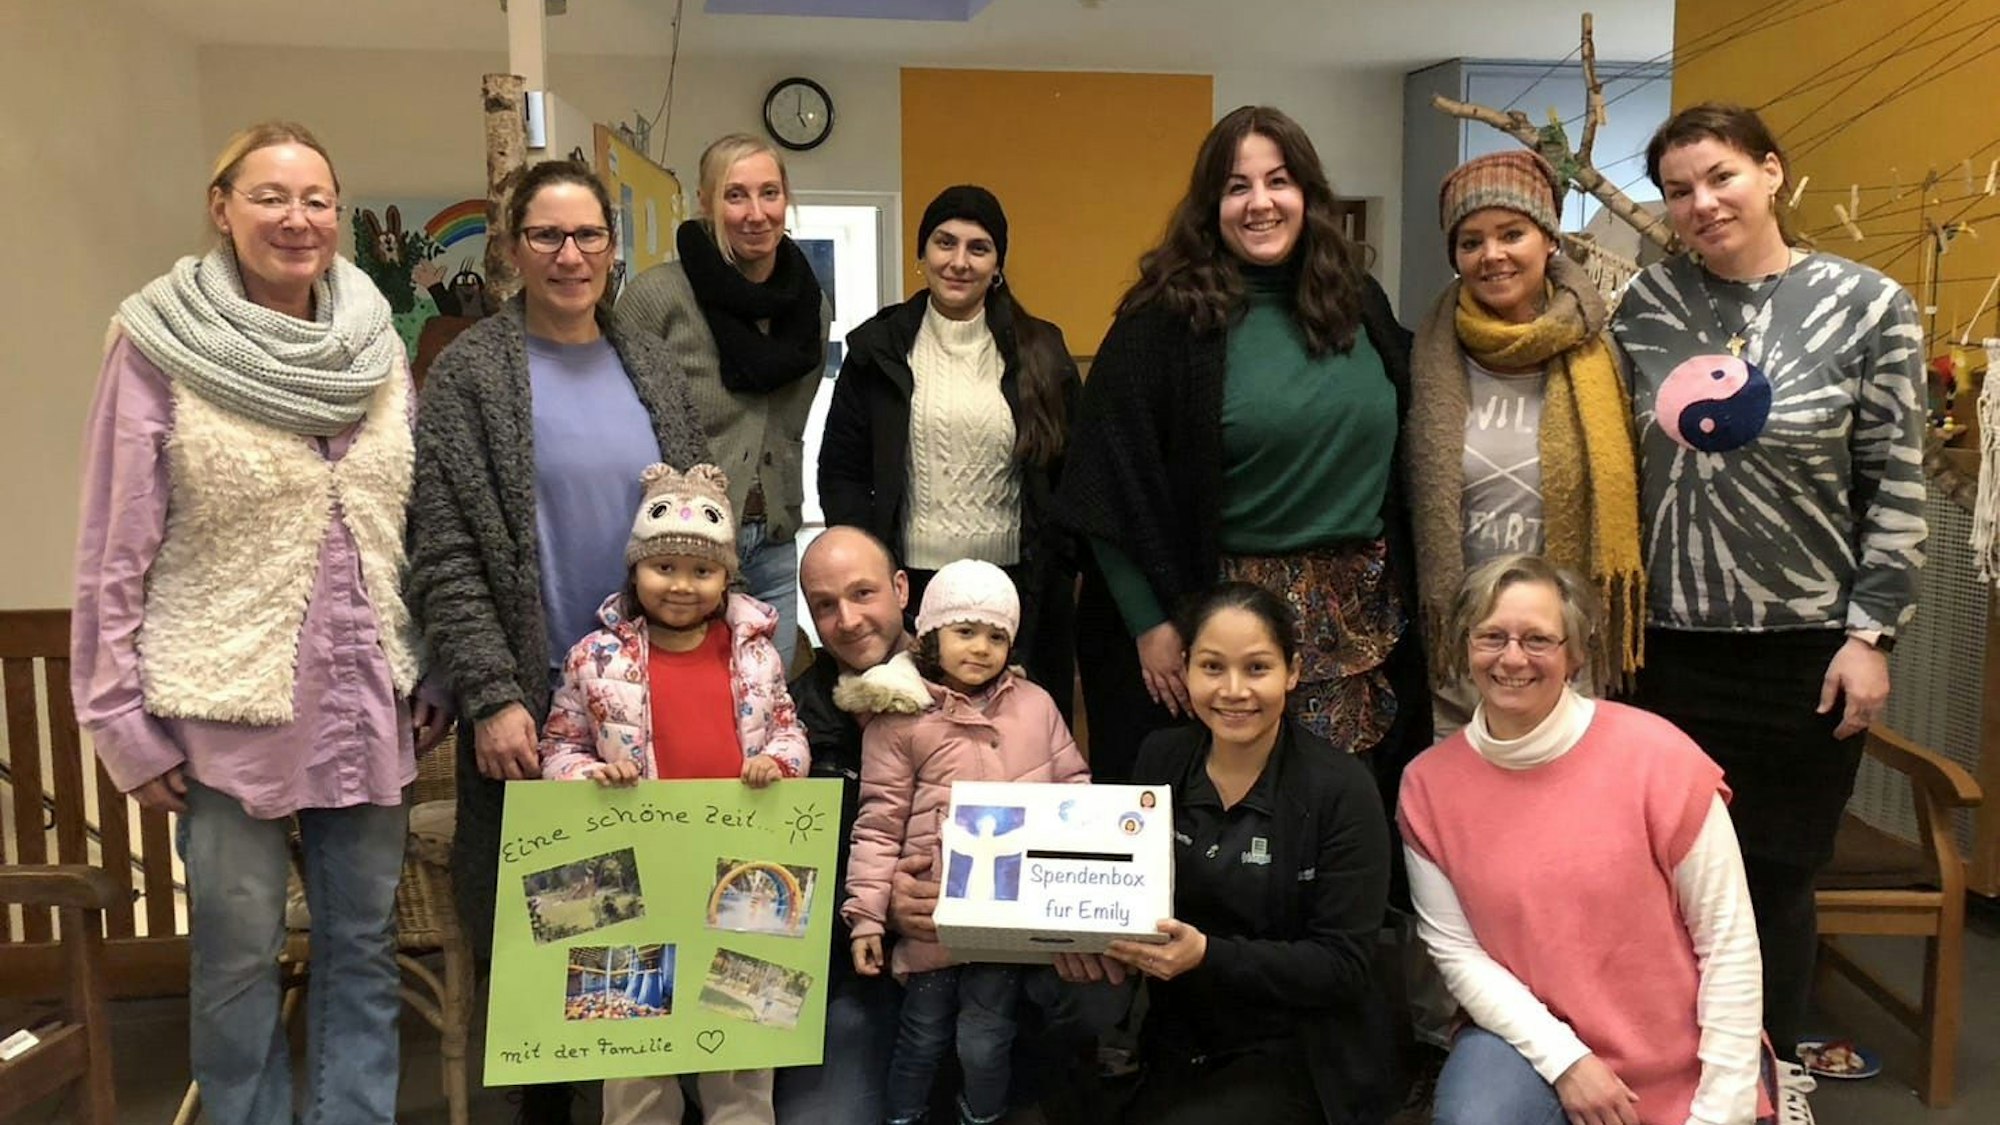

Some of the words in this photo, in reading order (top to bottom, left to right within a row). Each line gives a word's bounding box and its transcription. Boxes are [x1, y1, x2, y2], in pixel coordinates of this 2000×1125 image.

[502, 828, 571, 863] Eine
[586, 803, 691, 833] schöne
[1030, 863, 1146, 889] Spendenbox
[1078, 900, 1131, 928] Emily
[500, 1041, 541, 1064] mit
[554, 1043, 590, 1059] der
[597, 1037, 674, 1056] Familie
